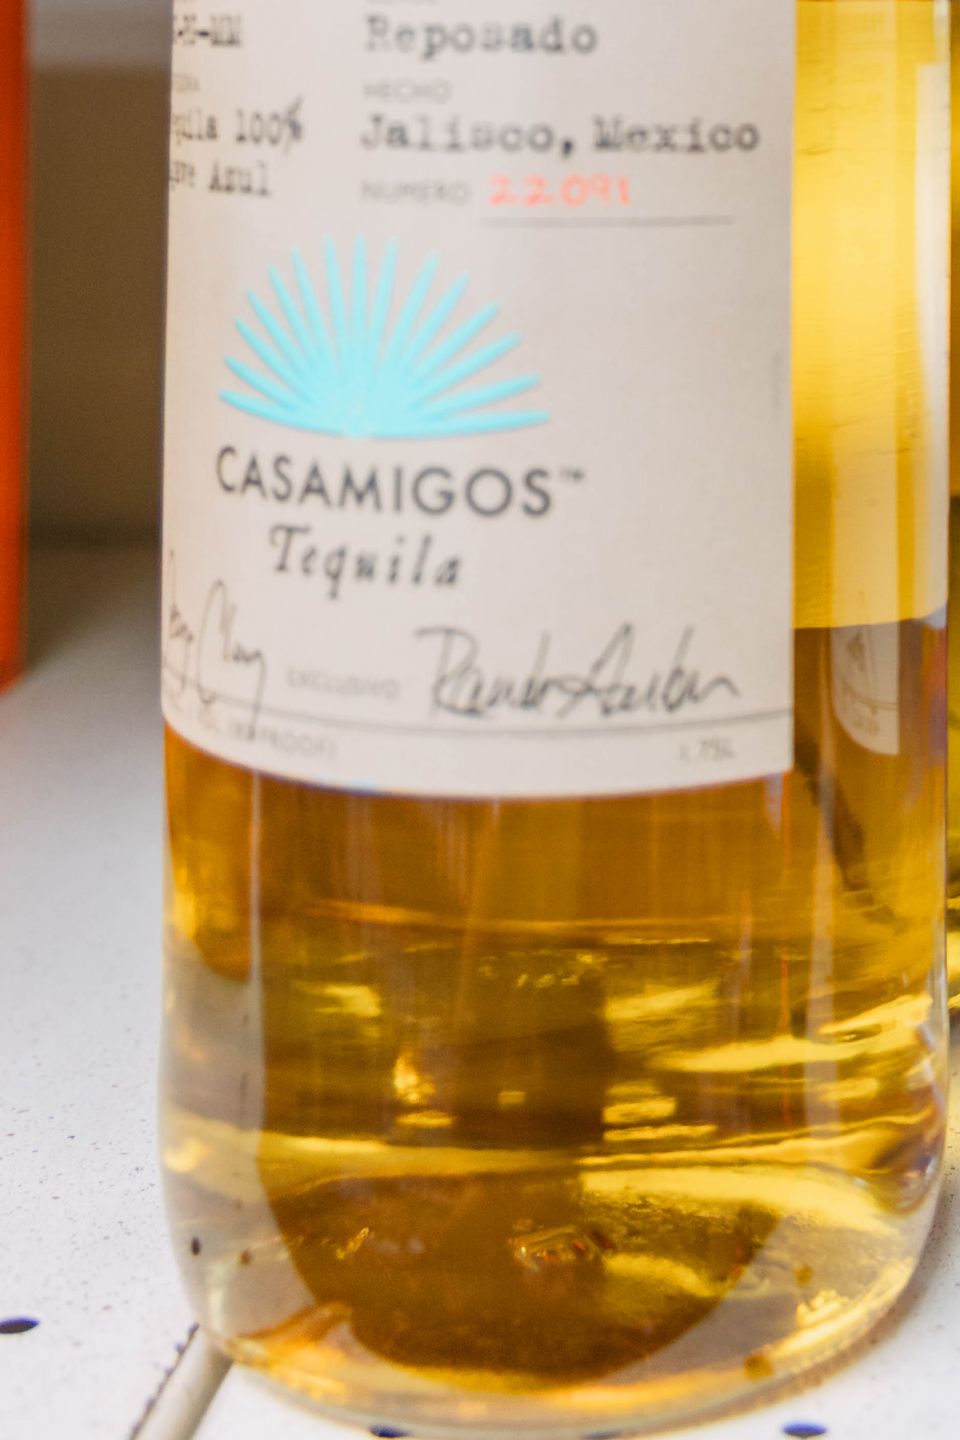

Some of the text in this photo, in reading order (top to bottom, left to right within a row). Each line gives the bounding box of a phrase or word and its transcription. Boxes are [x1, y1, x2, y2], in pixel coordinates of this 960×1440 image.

[366, 14, 597, 61] Reposado
[360, 114, 760, 160] Jalisco, Mexico
[488, 171, 632, 208] 22091
[268, 523, 464, 601] Tequila
